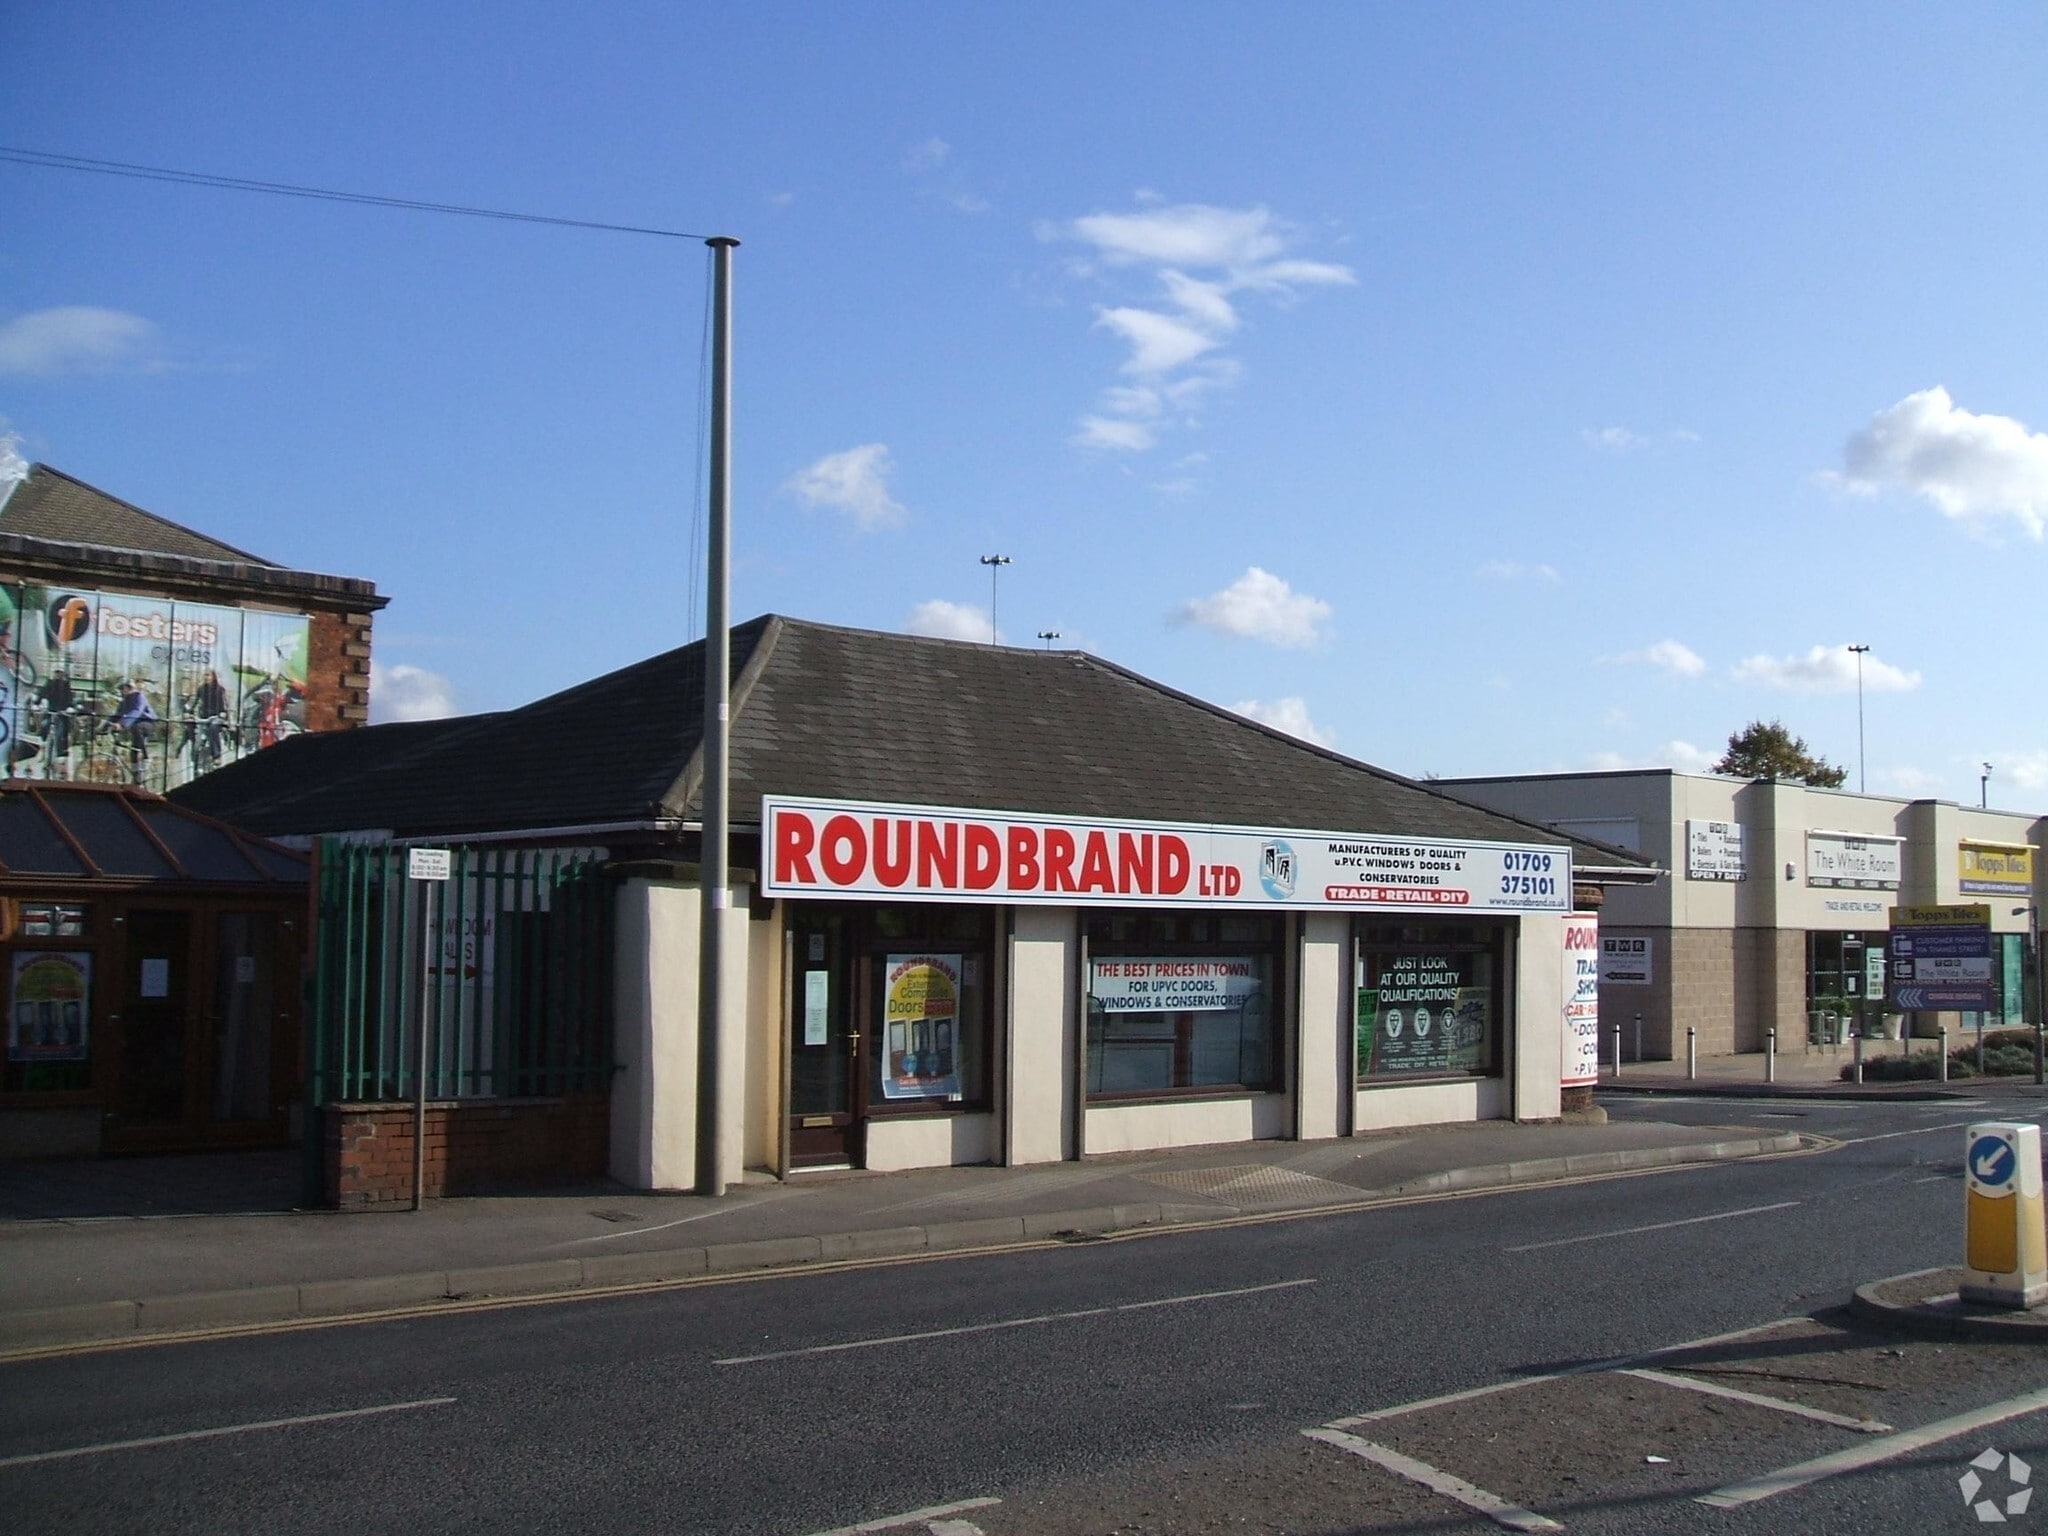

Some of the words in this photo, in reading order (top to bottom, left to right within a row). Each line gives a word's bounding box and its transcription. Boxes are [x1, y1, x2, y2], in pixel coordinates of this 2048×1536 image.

[92, 607, 218, 646] fosters
[151, 646, 211, 665] cycles
[775, 811, 1190, 896] ROUNDBRAND
[1199, 864, 1242, 897] LTD
[1328, 843, 1410, 857] MANUFACTURERS
[1414, 848, 1426, 857] OF
[1429, 849, 1467, 859] QUALITY
[1366, 858, 1415, 870] WINDOWS
[1419, 861, 1451, 871] DOORS
[1454, 862, 1461, 871] &
[1504, 852, 1552, 872] 01709
[1814, 850, 1834, 869] The
[1837, 852, 1866, 872] White
[1869, 854, 1897, 872] Room
[1976, 852, 2004, 875] Topps
[1359, 873, 1440, 885] CONSERVATORIES
[1691, 870, 1715, 879] OPEN
[1717, 871, 1723, 880] 7
[1501, 875, 1555, 895] 375101
[1328, 888, 1379, 900] TRADE
[1386, 890, 1435, 902] RETAIL
[1440, 892, 1466, 903] DIY
[1909, 909, 1949, 920] Topps
[1951, 908, 1980, 919] Tiles
[1097, 963, 1119, 977] THE
[1123, 963, 1151, 977] BEST
[1155, 963, 1194, 977] PRICES
[1197, 963, 1209, 977] IN
[1214, 963, 1250, 977] TOWN
[1393, 957, 1417, 969] JUST
[1421, 957, 1447, 969] LOOK
[1380, 974, 1393, 985] AT
[1396, 973, 1417, 985] OUR
[1420, 972, 1460, 985] QUALITY
[1128, 981, 1149, 993] FOR
[1151, 981, 1178, 992] UPVC
[1181, 980, 1218, 993] DOORS,
[1099, 996, 1151, 1008] WINDOWS
[1154, 996, 1162, 1008] &
[1166, 994, 1247, 1008] CONSERVATORIES
[1380, 988, 1458, 1002] QUALIFICATIONS
[889, 999, 924, 1014] Doors
